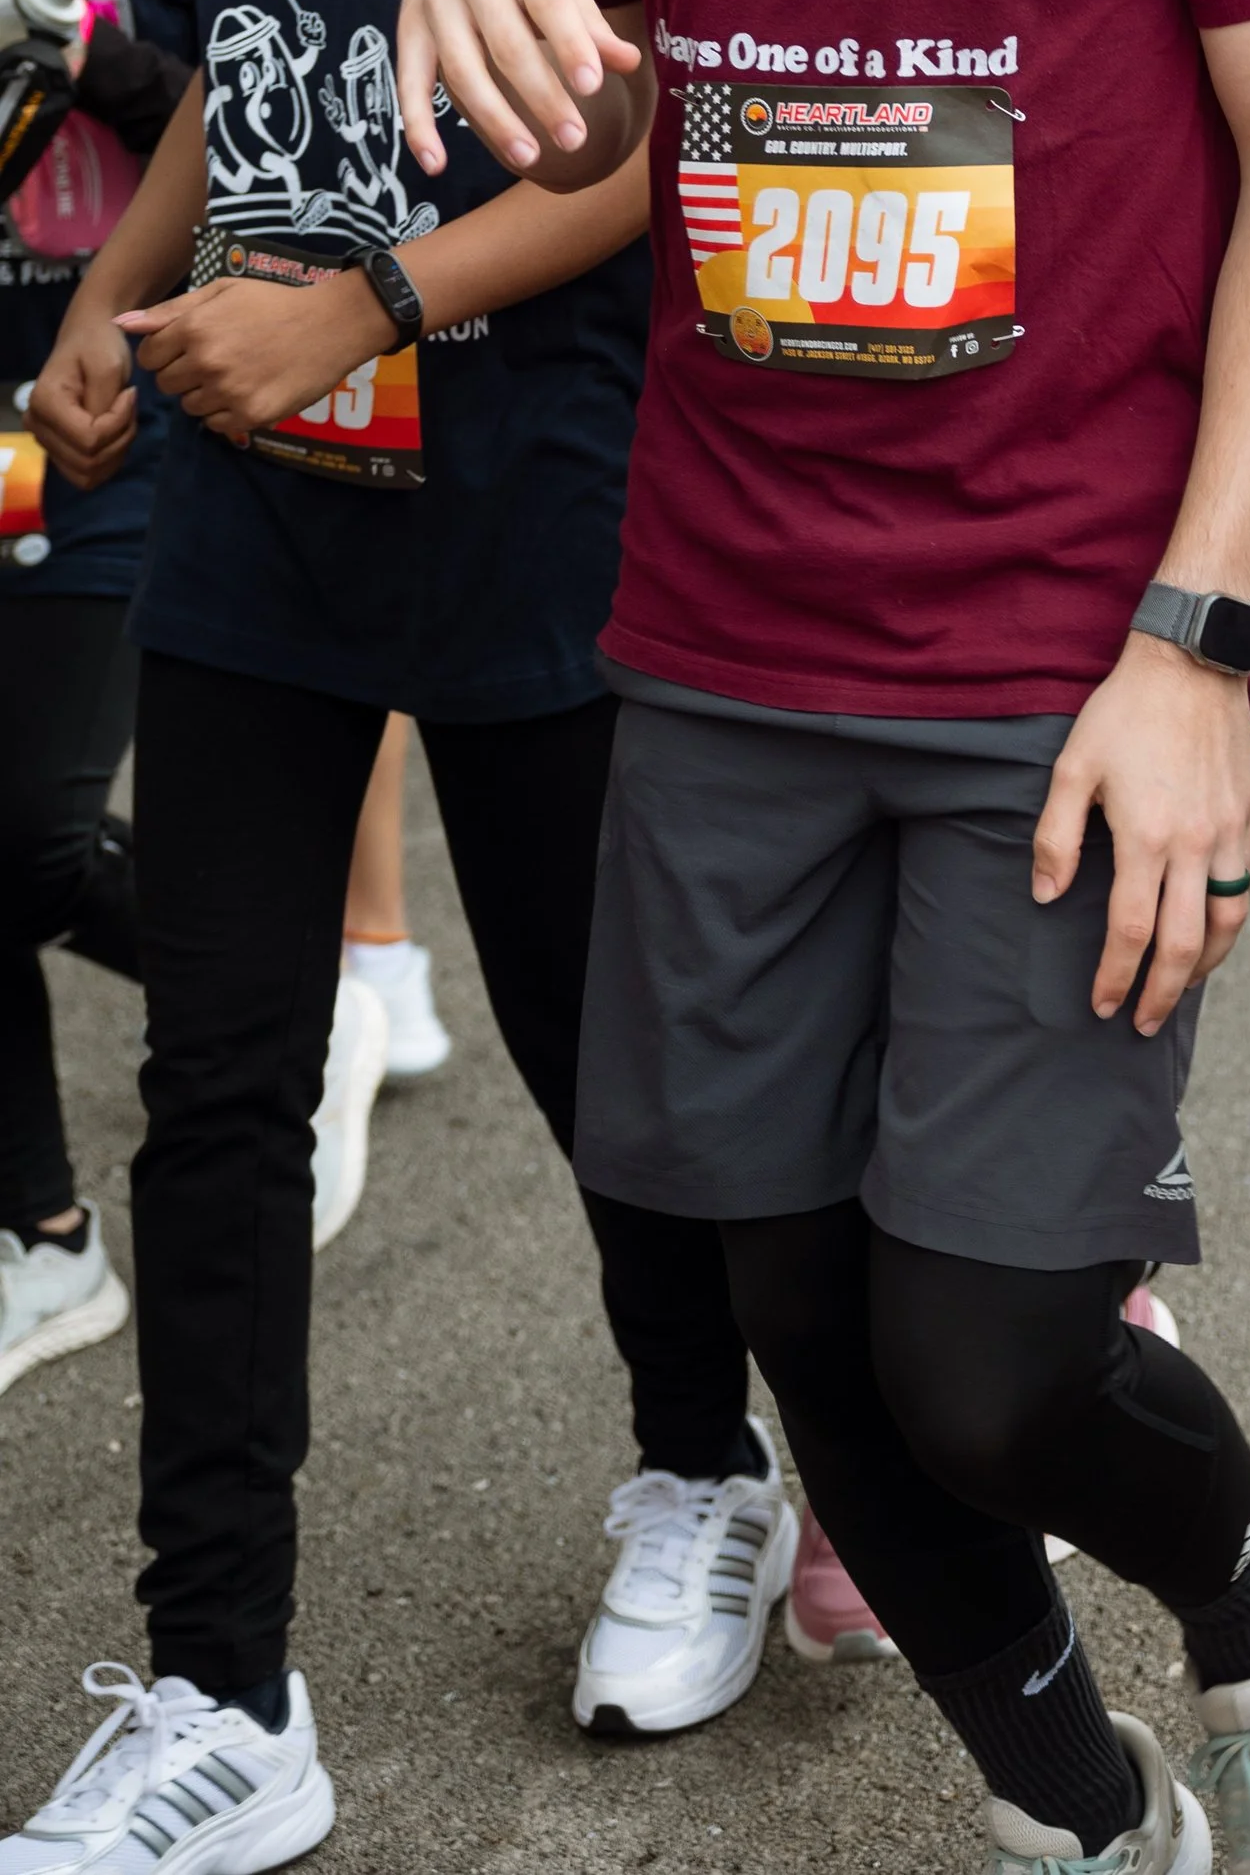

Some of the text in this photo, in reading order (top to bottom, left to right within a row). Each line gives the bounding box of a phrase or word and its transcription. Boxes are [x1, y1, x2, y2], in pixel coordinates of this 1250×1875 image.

[728, 32, 808, 76] One
[815, 37, 860, 77] of
[864, 50, 886, 78] a
[896, 36, 1019, 78] Kind
[775, 101, 934, 126] HEARTLAND
[745, 187, 971, 308] 2095
